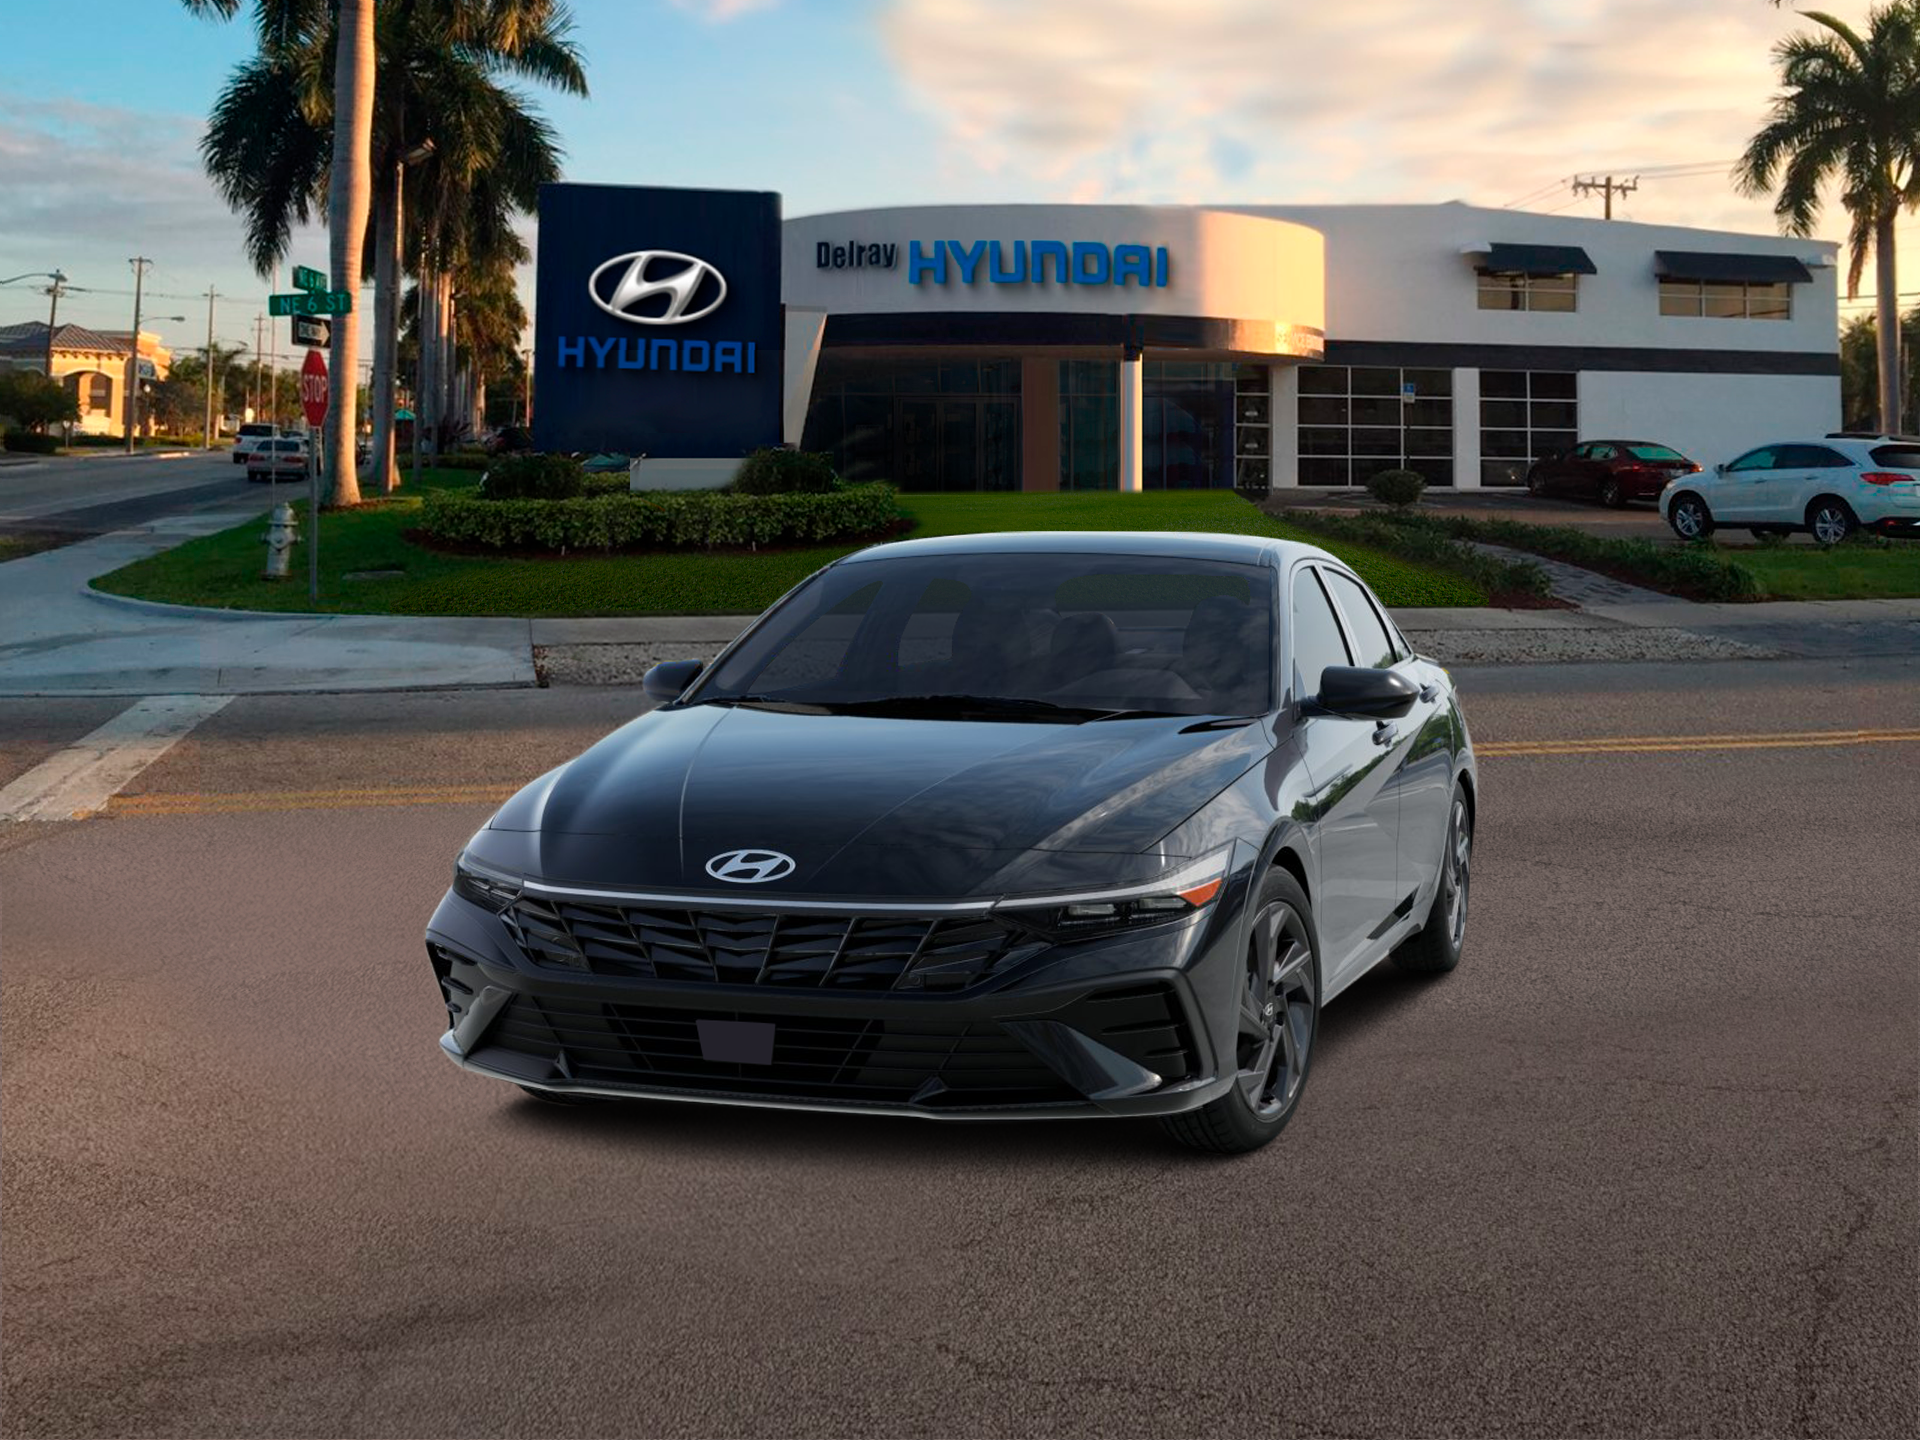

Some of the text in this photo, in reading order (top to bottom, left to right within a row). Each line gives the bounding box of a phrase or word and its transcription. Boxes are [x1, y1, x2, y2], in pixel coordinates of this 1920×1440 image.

[817, 240, 1168, 288] Delray HYUNDAI
[280, 294, 345, 313] NE 6 ST
[557, 336, 756, 374] HYUNDAI
[304, 374, 327, 403] STOP
